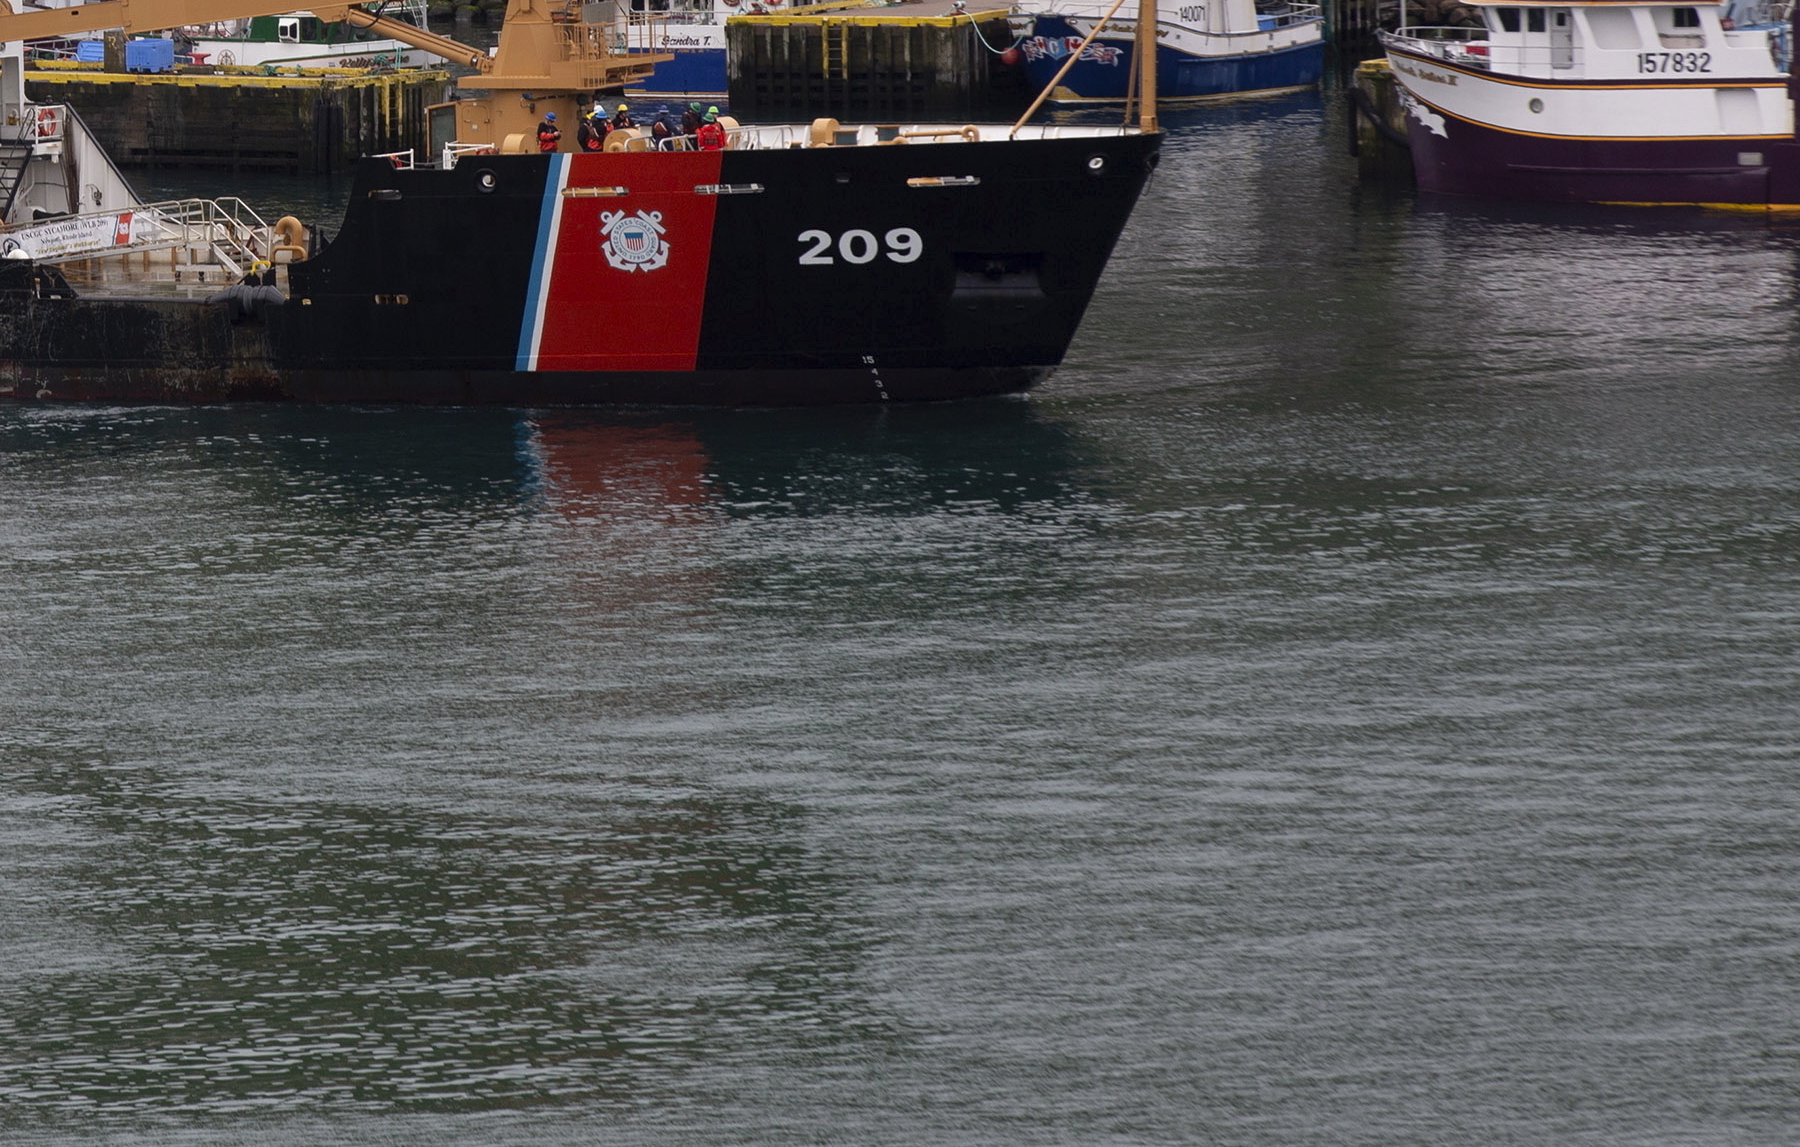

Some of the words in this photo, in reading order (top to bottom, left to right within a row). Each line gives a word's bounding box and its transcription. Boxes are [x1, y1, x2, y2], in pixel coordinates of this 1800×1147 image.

[1179, 6, 1207, 22] 140071
[661, 35, 700, 46] Sandra
[703, 35, 711, 46] T.
[1637, 52, 1712, 73] 157832
[21, 232, 43, 241] USCGC
[44, 224, 78, 235] SYCAMORE
[614, 220, 633, 234] STATES
[634, 220, 654, 234] COAST
[798, 227, 923, 265] 209
